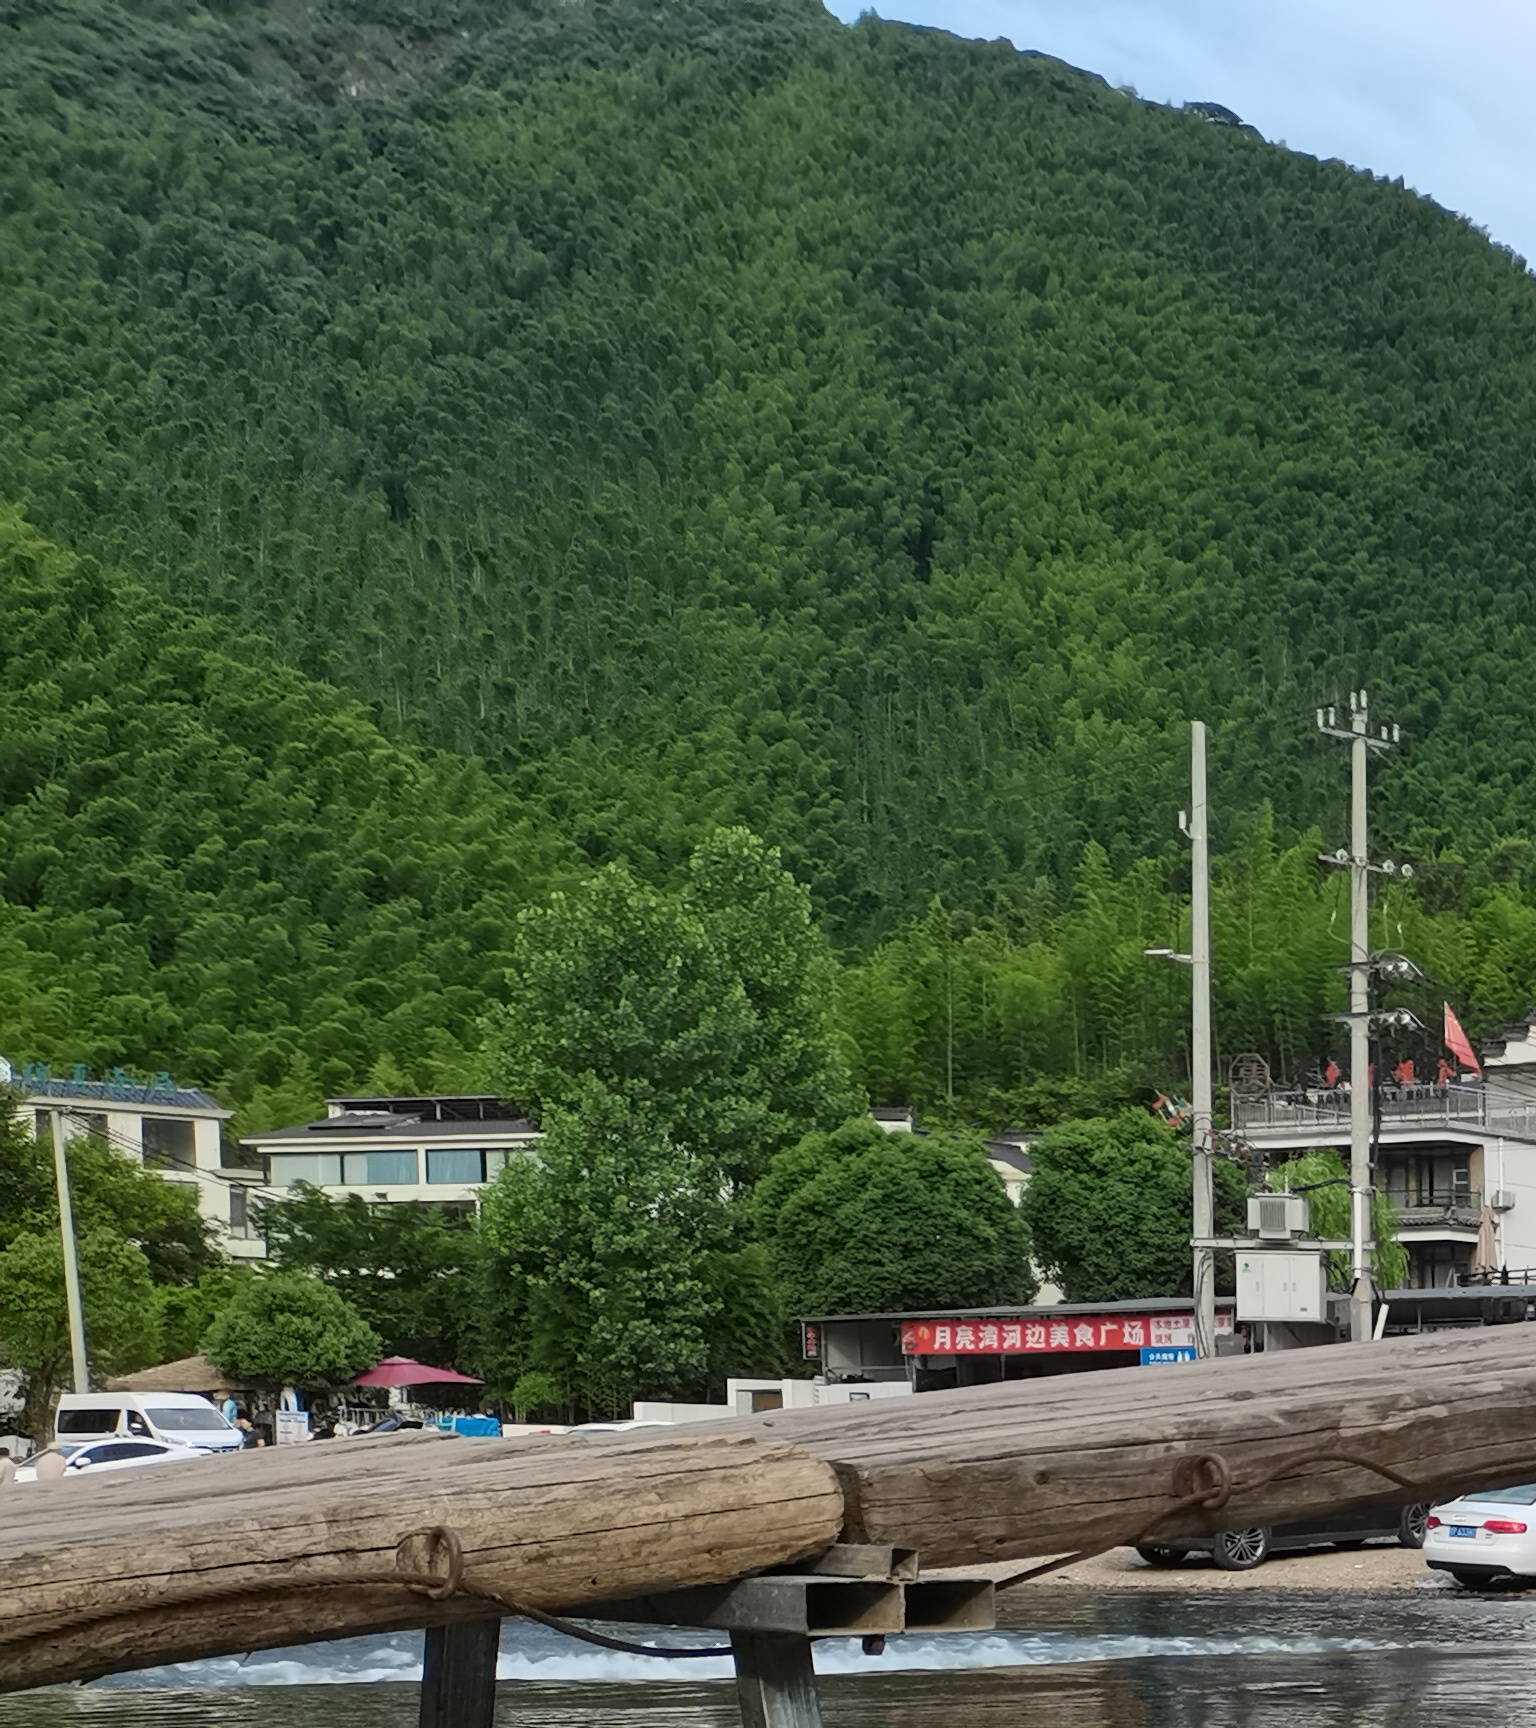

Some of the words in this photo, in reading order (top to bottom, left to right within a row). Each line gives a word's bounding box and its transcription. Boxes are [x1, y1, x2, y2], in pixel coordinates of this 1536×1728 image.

[933, 1322, 1145, 1350] 月亮湾河边美食广场
